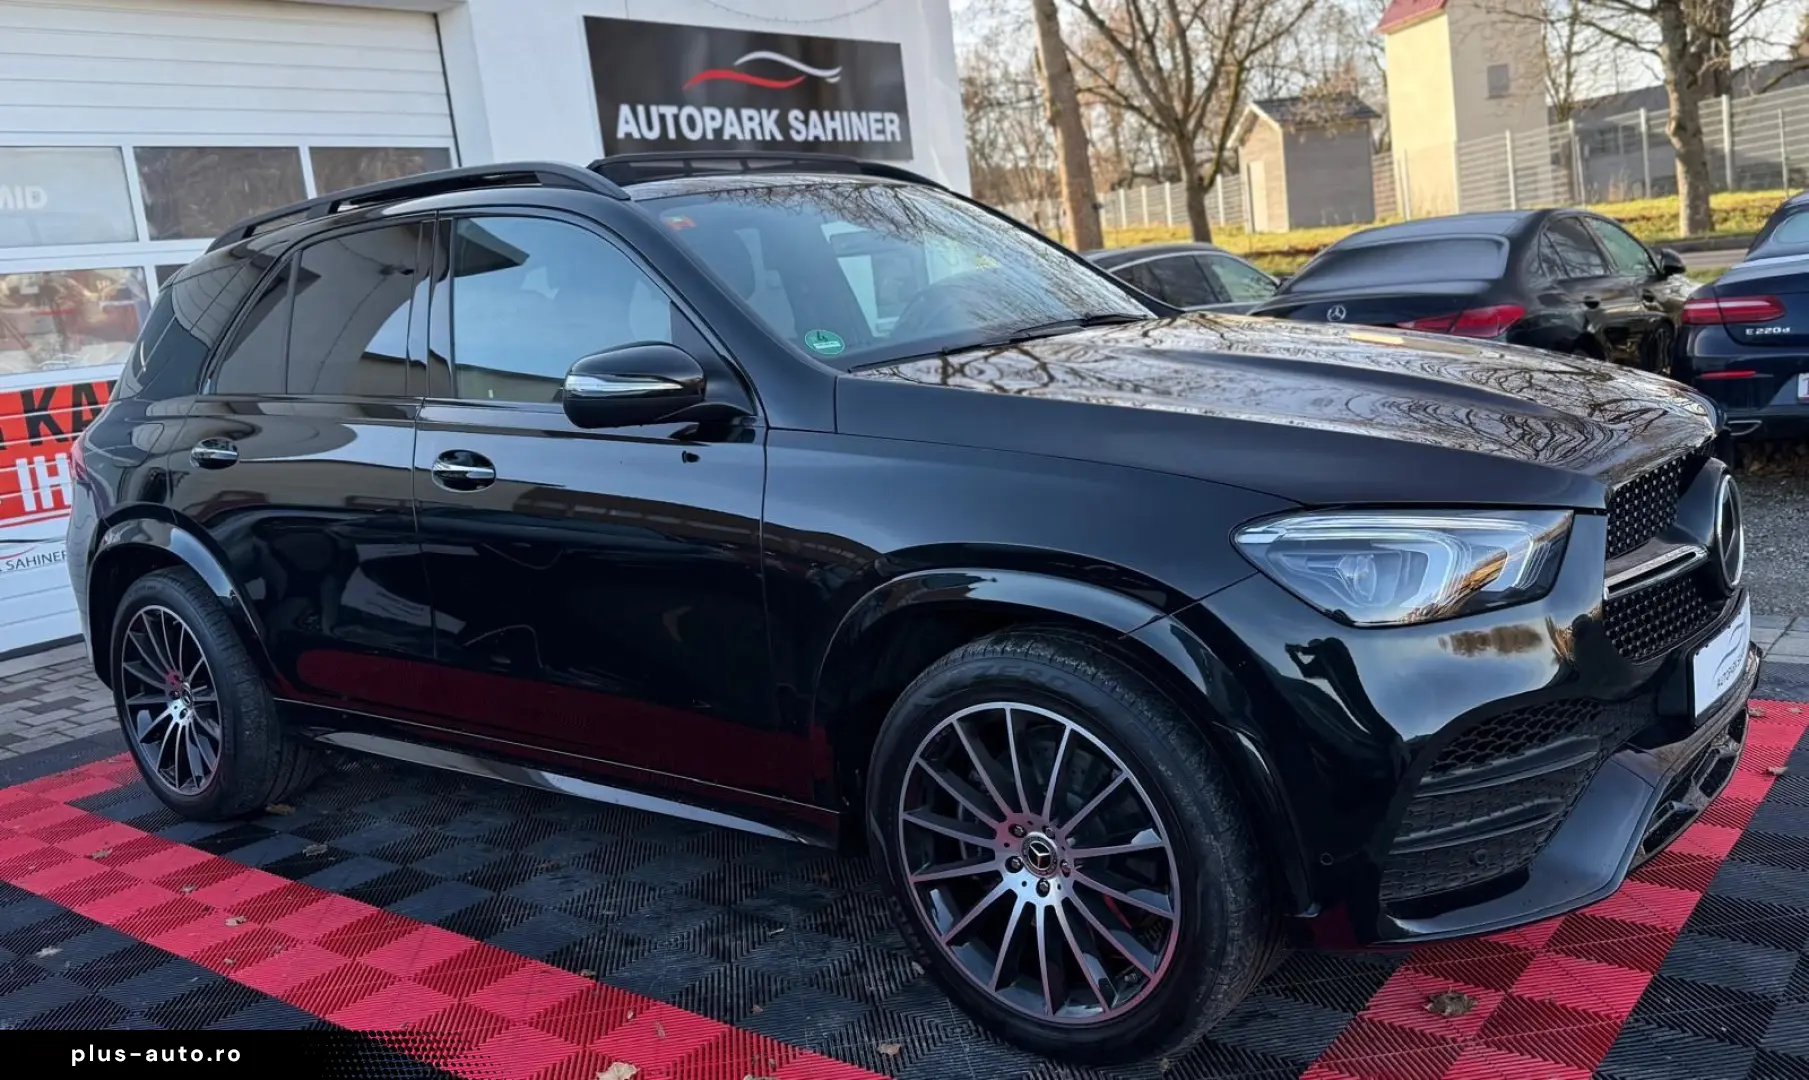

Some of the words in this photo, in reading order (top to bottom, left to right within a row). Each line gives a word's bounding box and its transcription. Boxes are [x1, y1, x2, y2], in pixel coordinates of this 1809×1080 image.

[615, 103, 784, 142] AUTOPARK
[787, 109, 902, 142] SAHINER
[20, 380, 118, 447] KA
